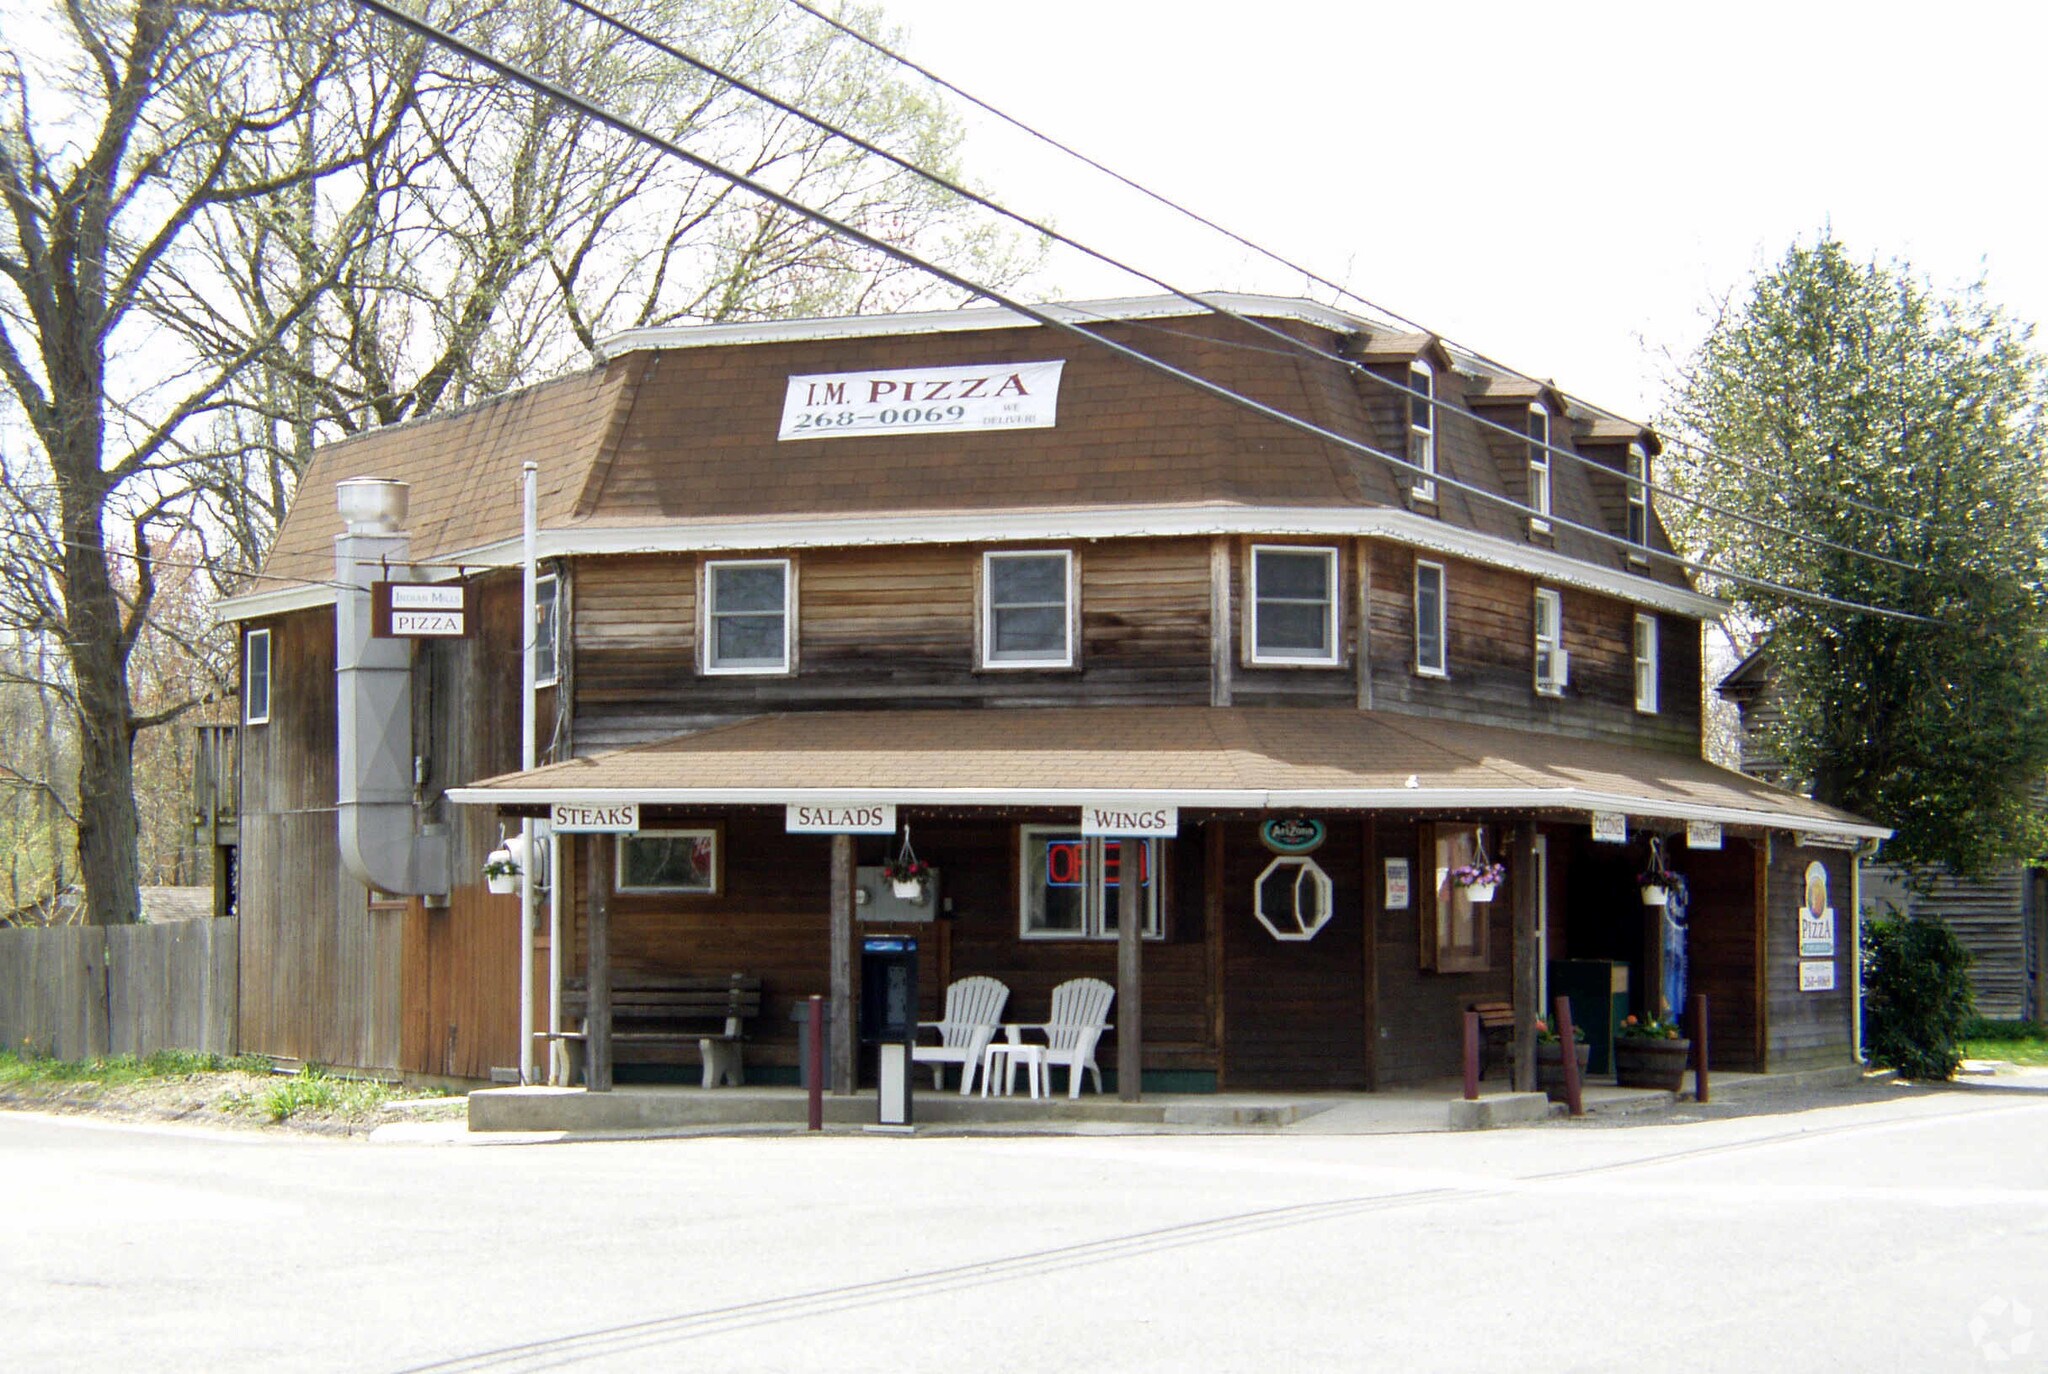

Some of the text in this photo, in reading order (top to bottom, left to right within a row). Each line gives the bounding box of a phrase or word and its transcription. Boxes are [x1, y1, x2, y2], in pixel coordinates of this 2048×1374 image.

[806, 373, 1030, 407] I.M. PIZZA
[794, 405, 966, 429] 268-0069
[398, 617, 457, 631] PIZZA
[556, 806, 633, 826] STEAKS
[799, 807, 884, 827] SALADS
[1094, 809, 1167, 830] WINGS
[1802, 919, 1832, 939] PIZZA
